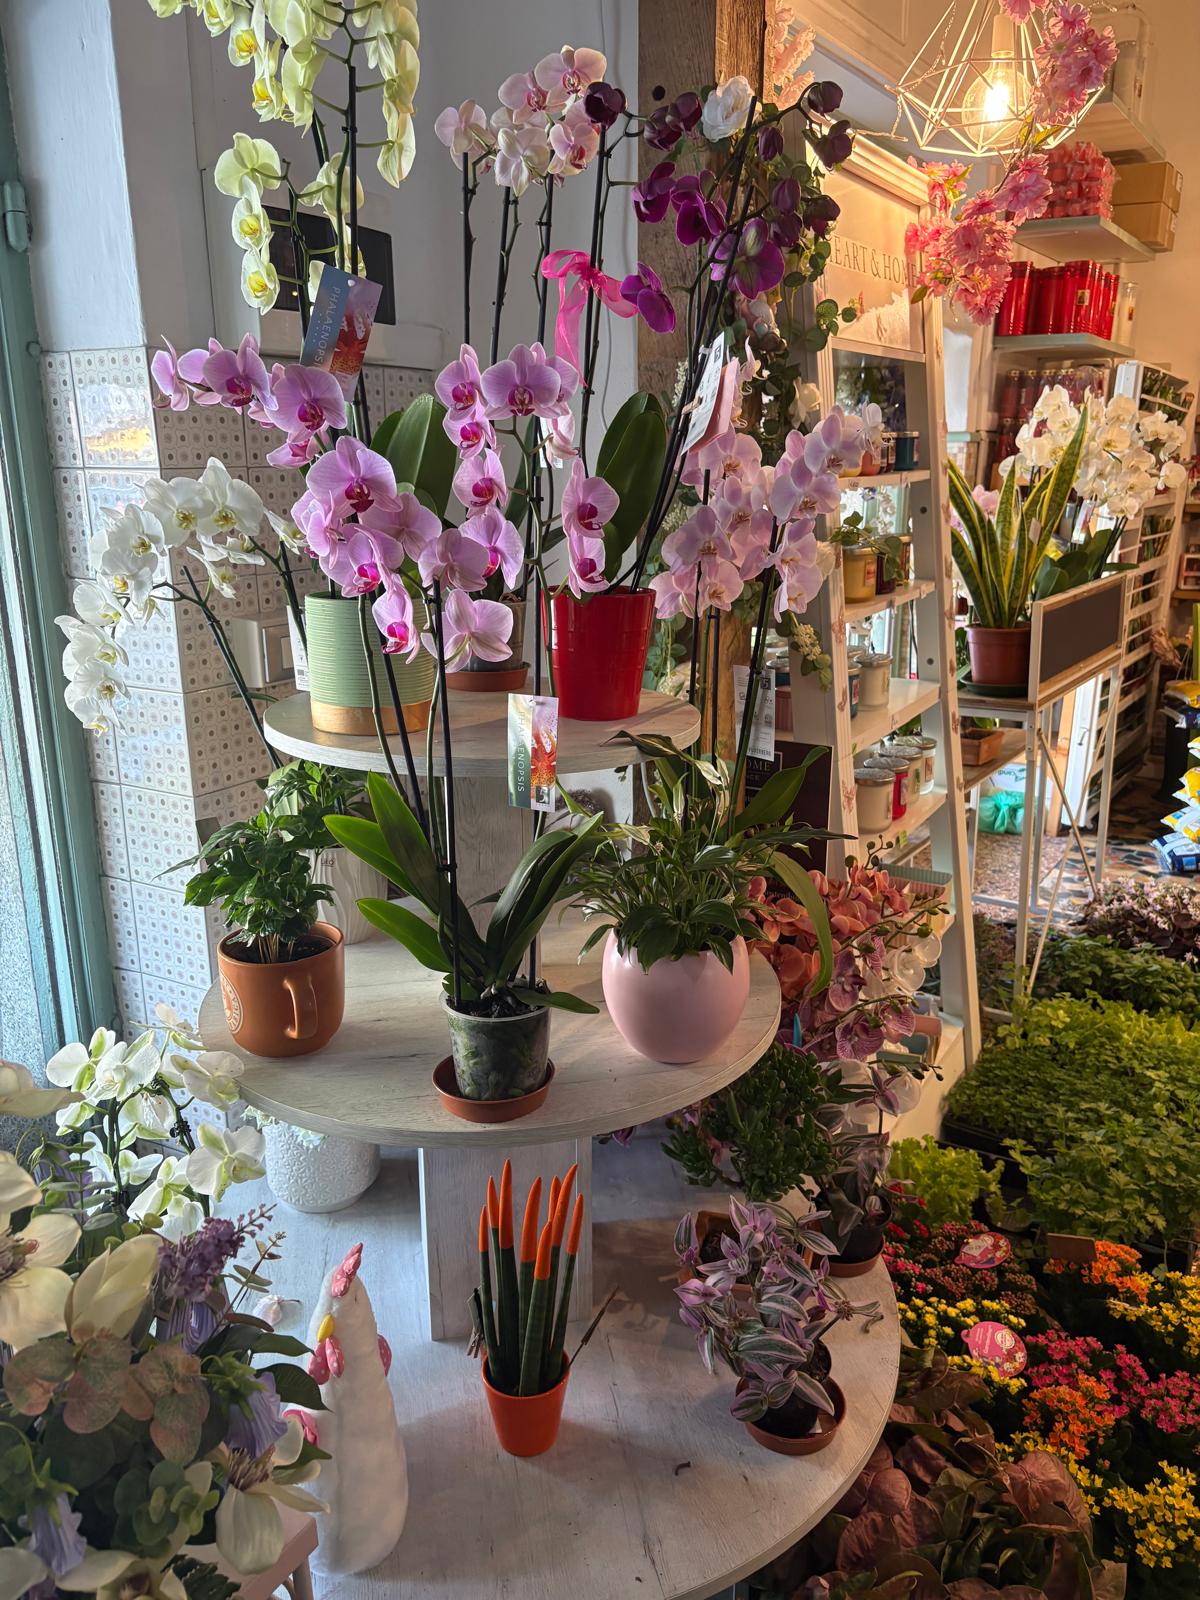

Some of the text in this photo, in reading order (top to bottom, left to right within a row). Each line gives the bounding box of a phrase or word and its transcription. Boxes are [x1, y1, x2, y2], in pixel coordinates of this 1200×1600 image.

[829, 235, 867, 274] EART
[870, 248, 882, 279] &
[313, 286, 341, 366] PHALAENOPSI
